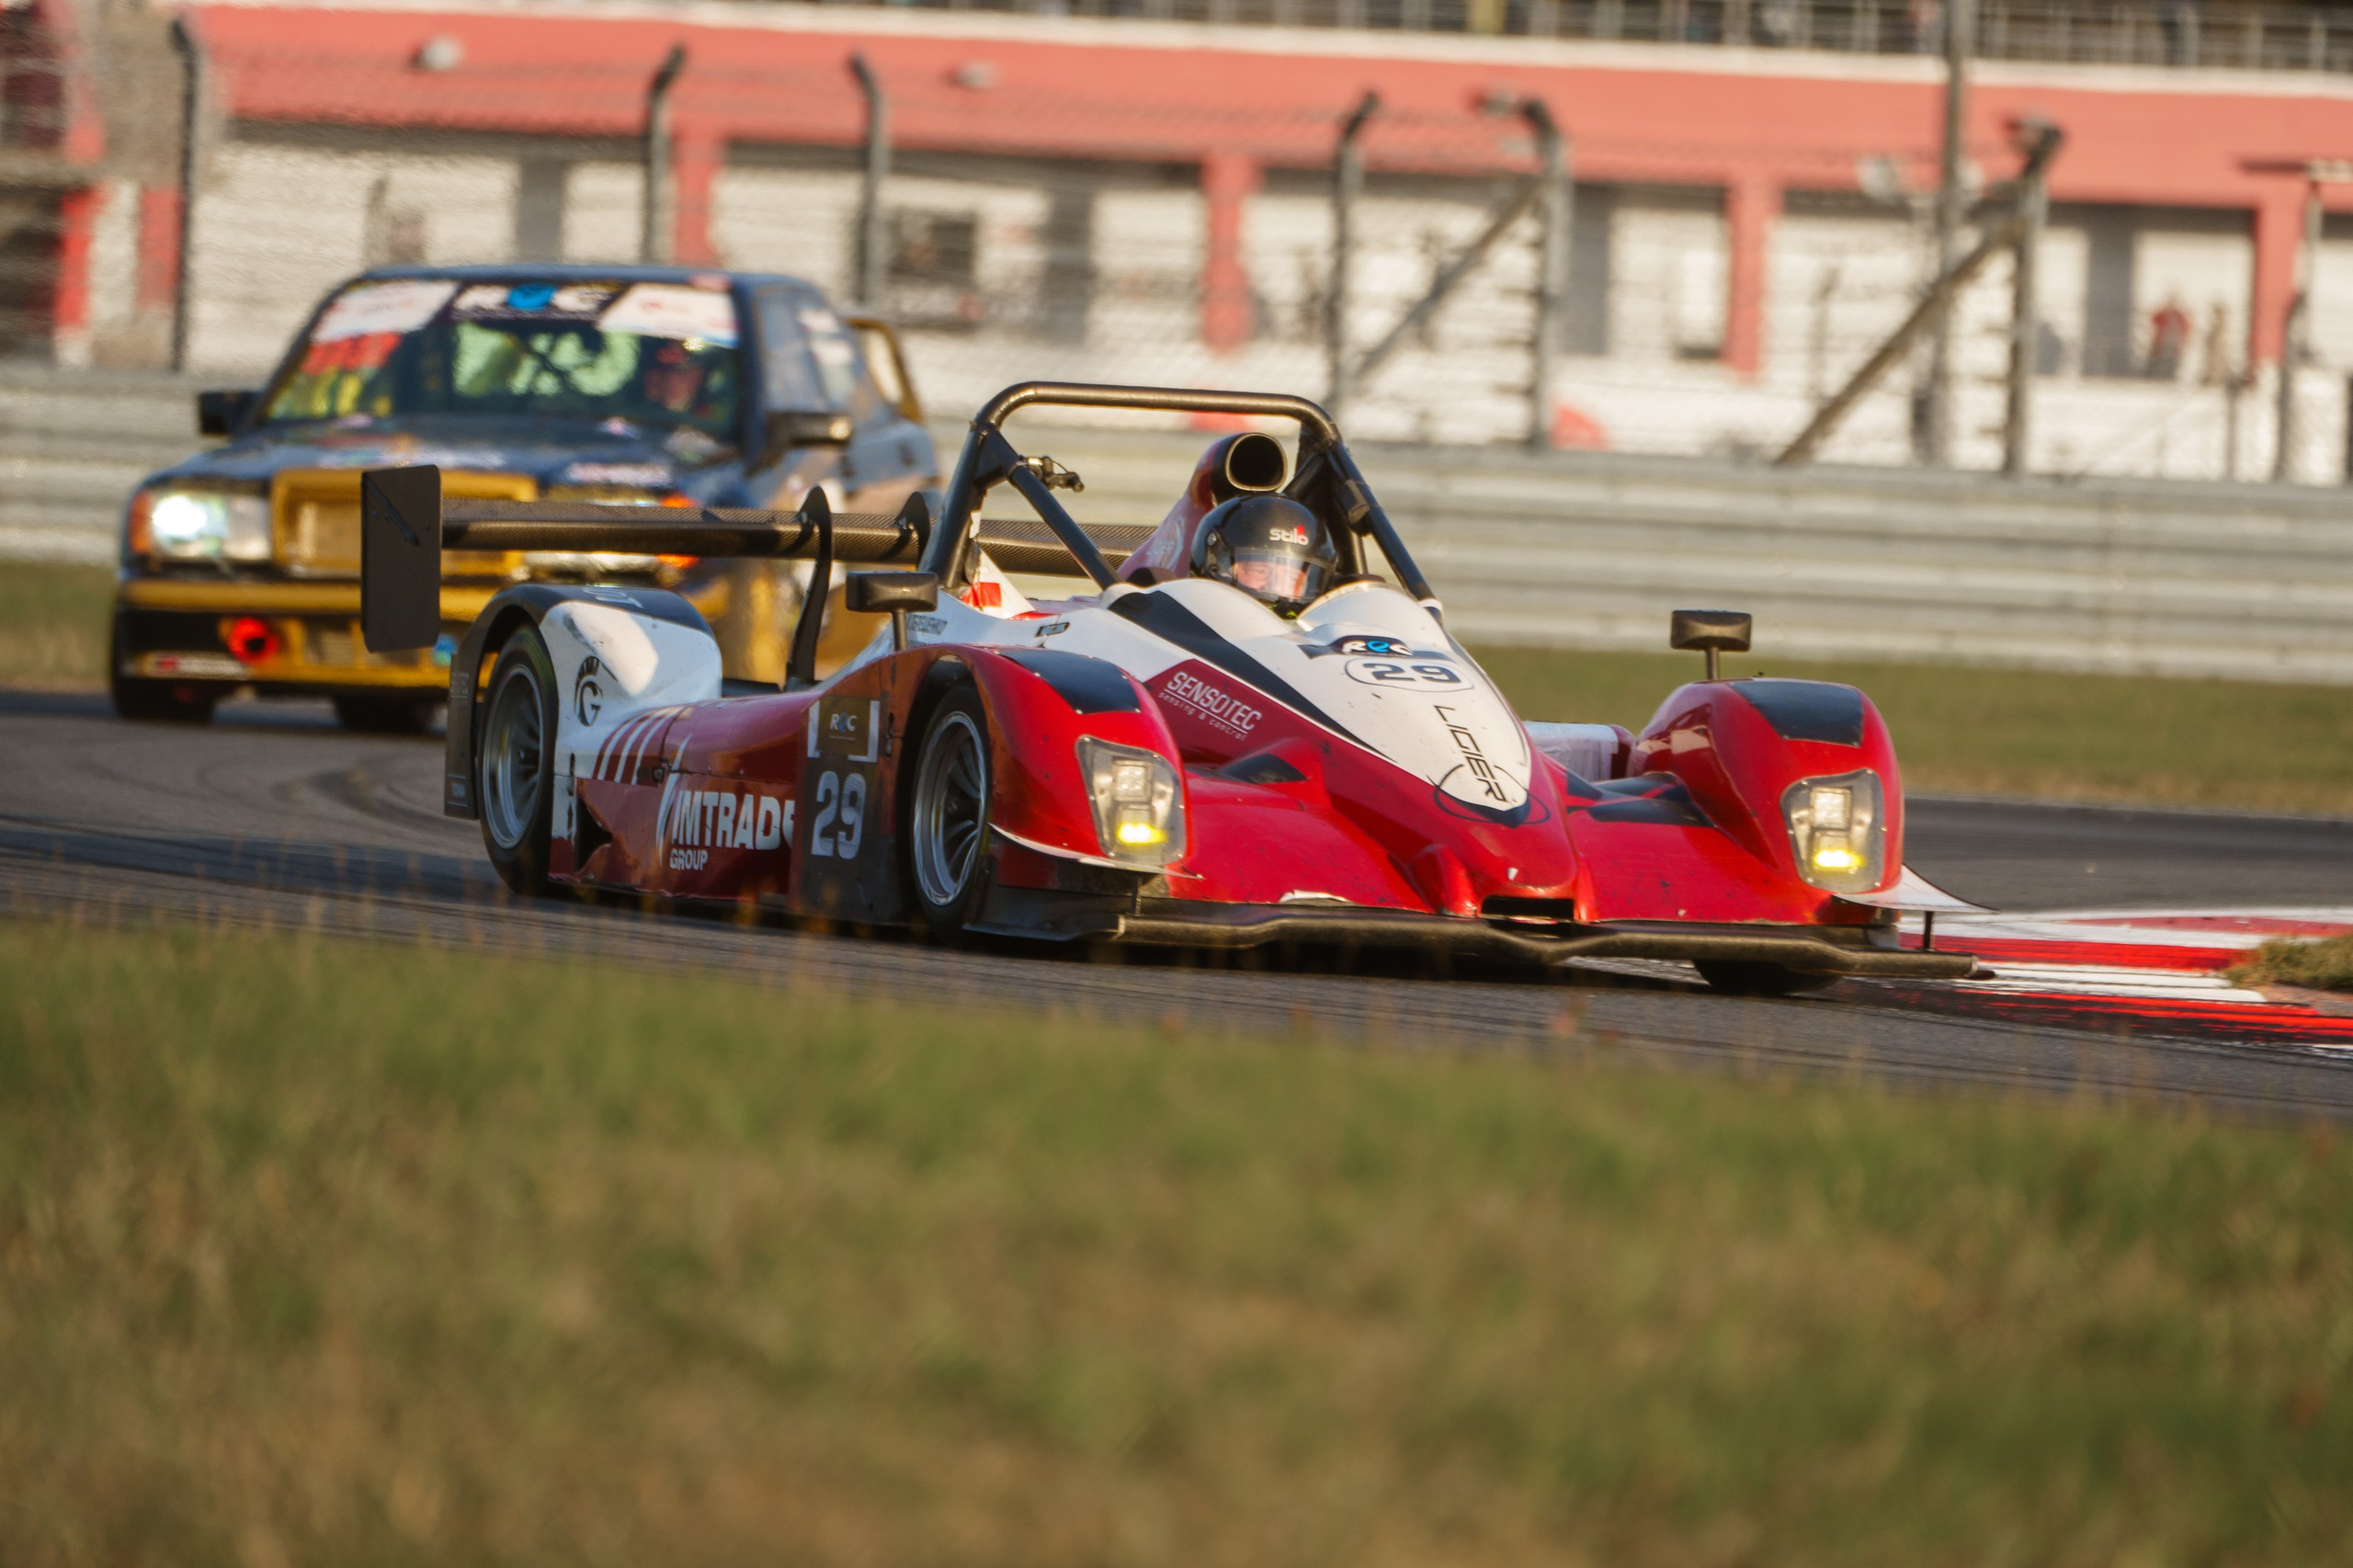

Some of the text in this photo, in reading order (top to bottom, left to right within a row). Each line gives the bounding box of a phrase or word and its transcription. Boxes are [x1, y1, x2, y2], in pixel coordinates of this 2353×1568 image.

[1269, 527, 1309, 545] Stilo
[1362, 663, 1461, 683] 29
[1158, 692, 1196, 716] sensing
[1198, 712, 1208, 721] &
[1166, 672, 1263, 731] SENSOTEC
[1434, 705, 1508, 802] LIGIER
[811, 770, 867, 859] 29
[669, 848, 709, 870] GROUP
